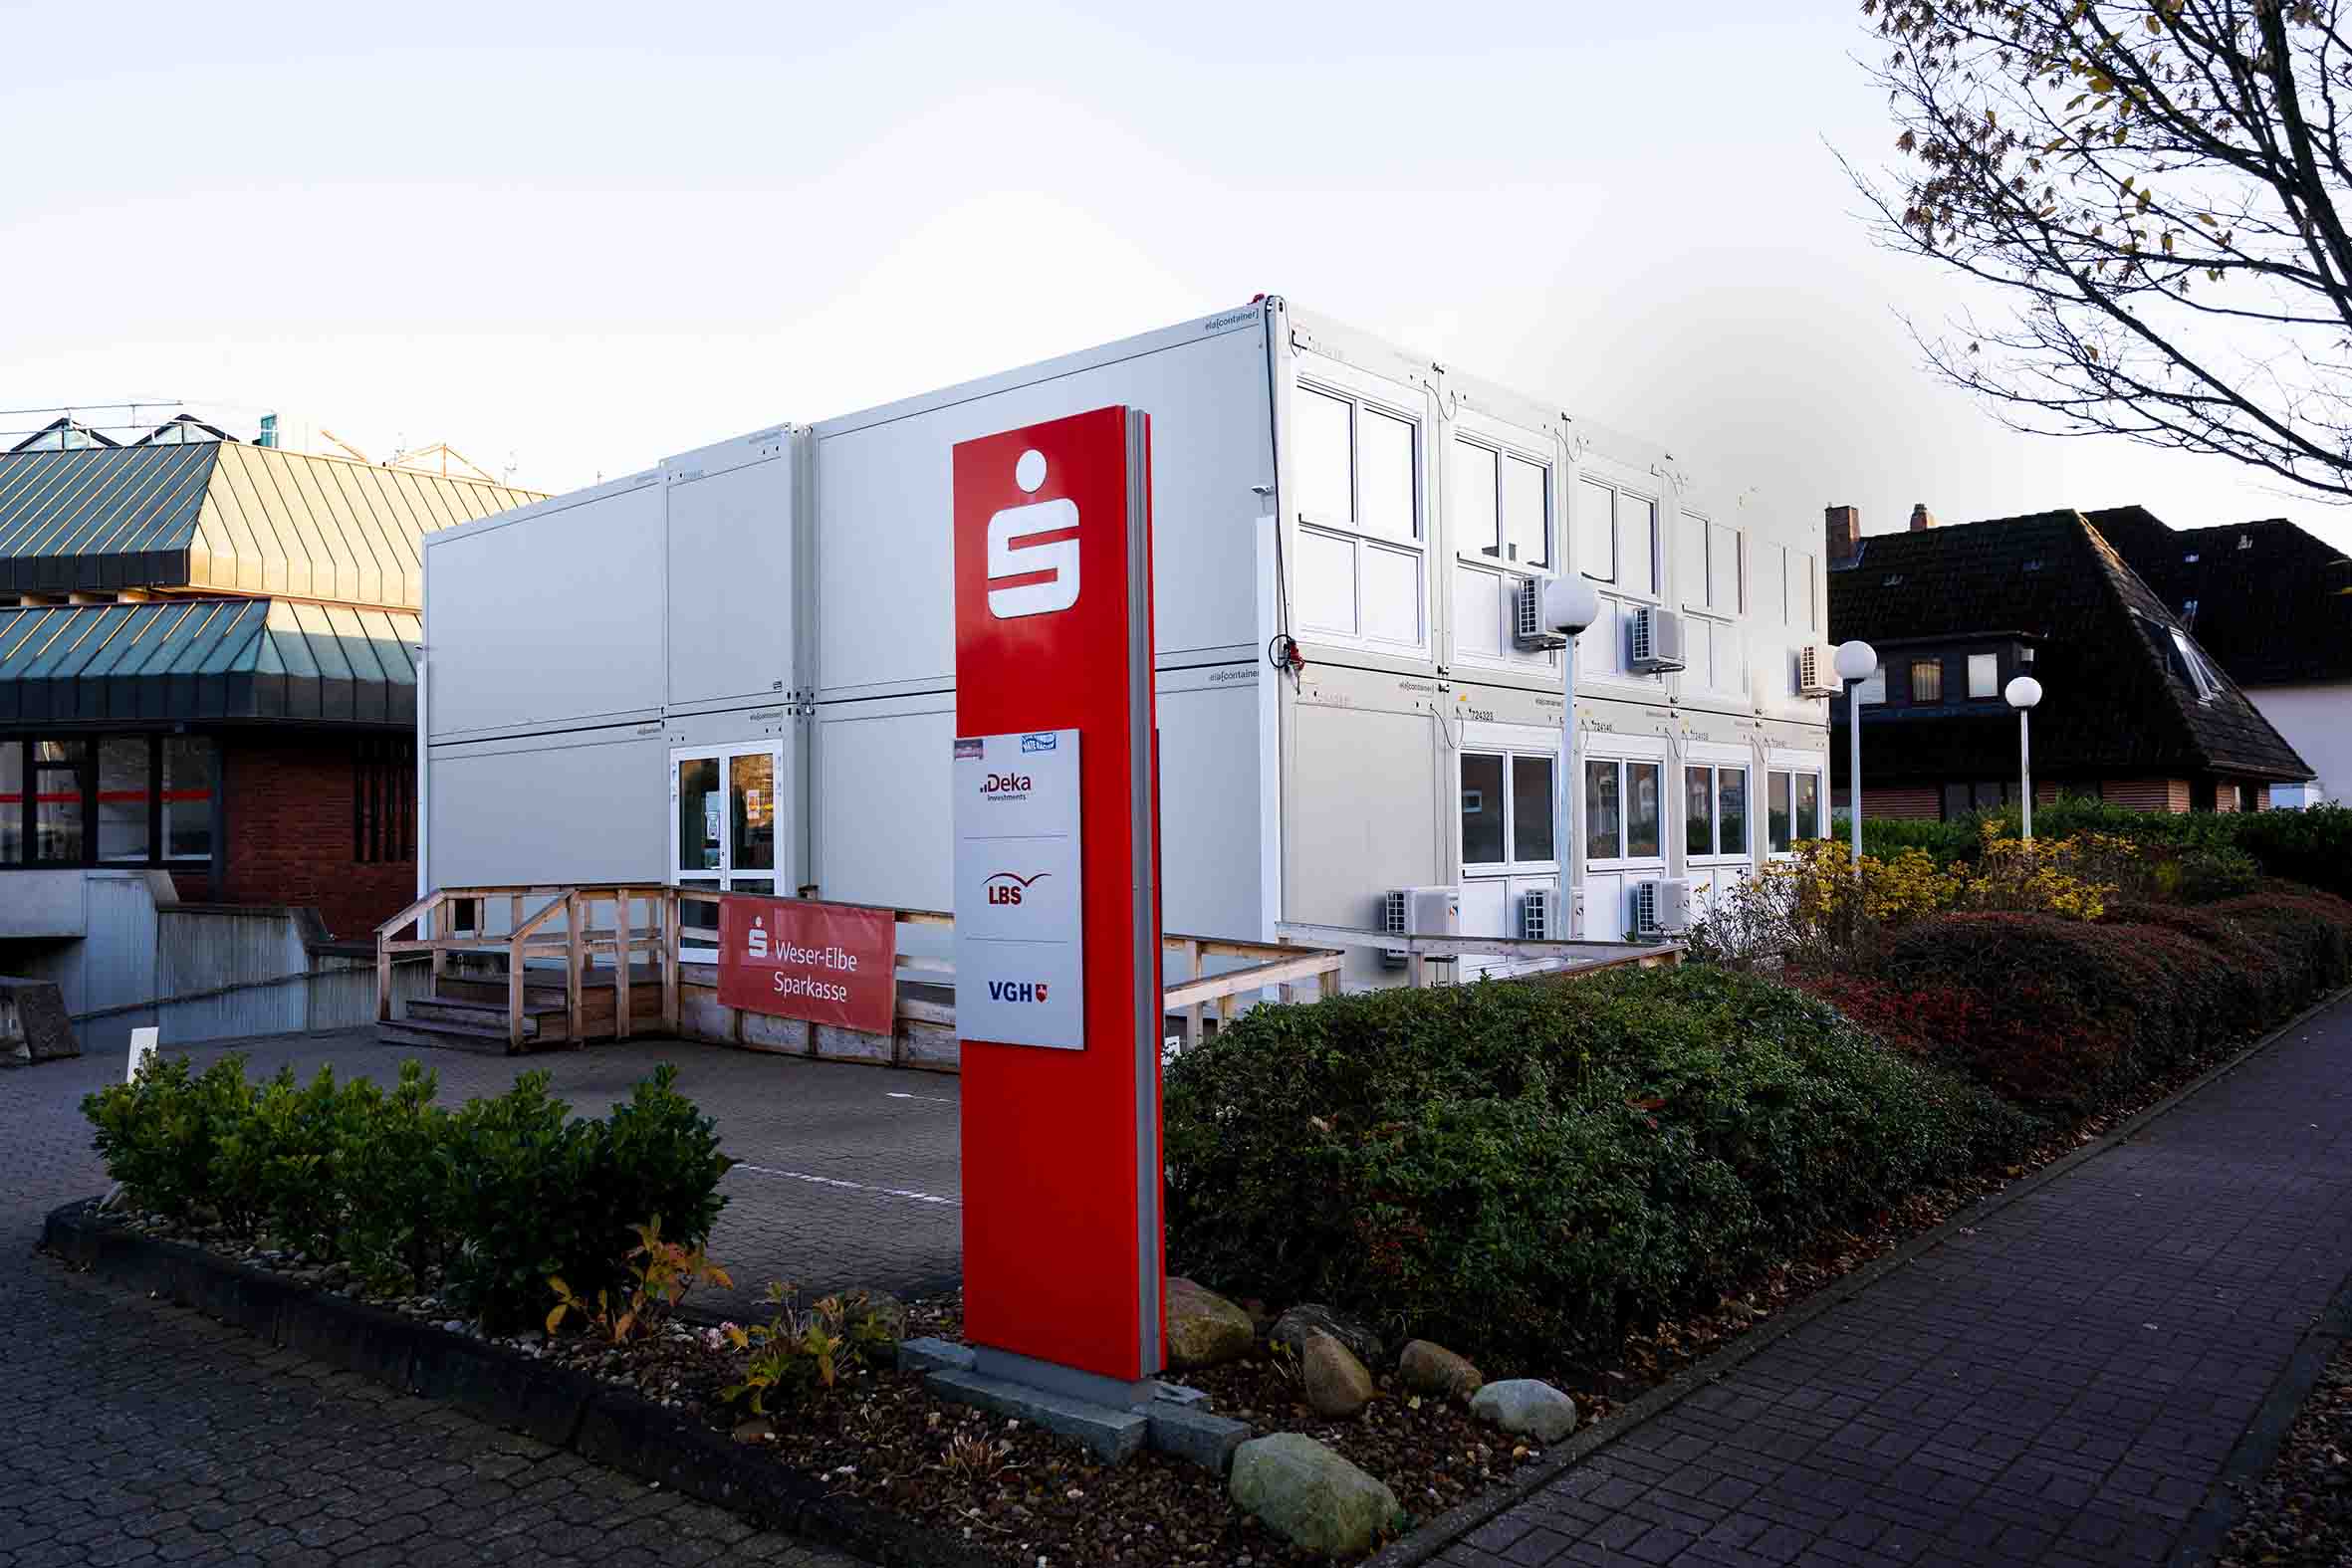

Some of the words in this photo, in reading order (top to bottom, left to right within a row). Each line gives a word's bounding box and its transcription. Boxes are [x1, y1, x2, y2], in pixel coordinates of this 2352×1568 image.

[987, 772, 1032, 793] Deka
[989, 885, 1023, 905] LBS
[775, 939, 857, 973] Weser-Elbe
[773, 971, 846, 1004] Sparkasse
[988, 980, 1034, 1003] VGH
